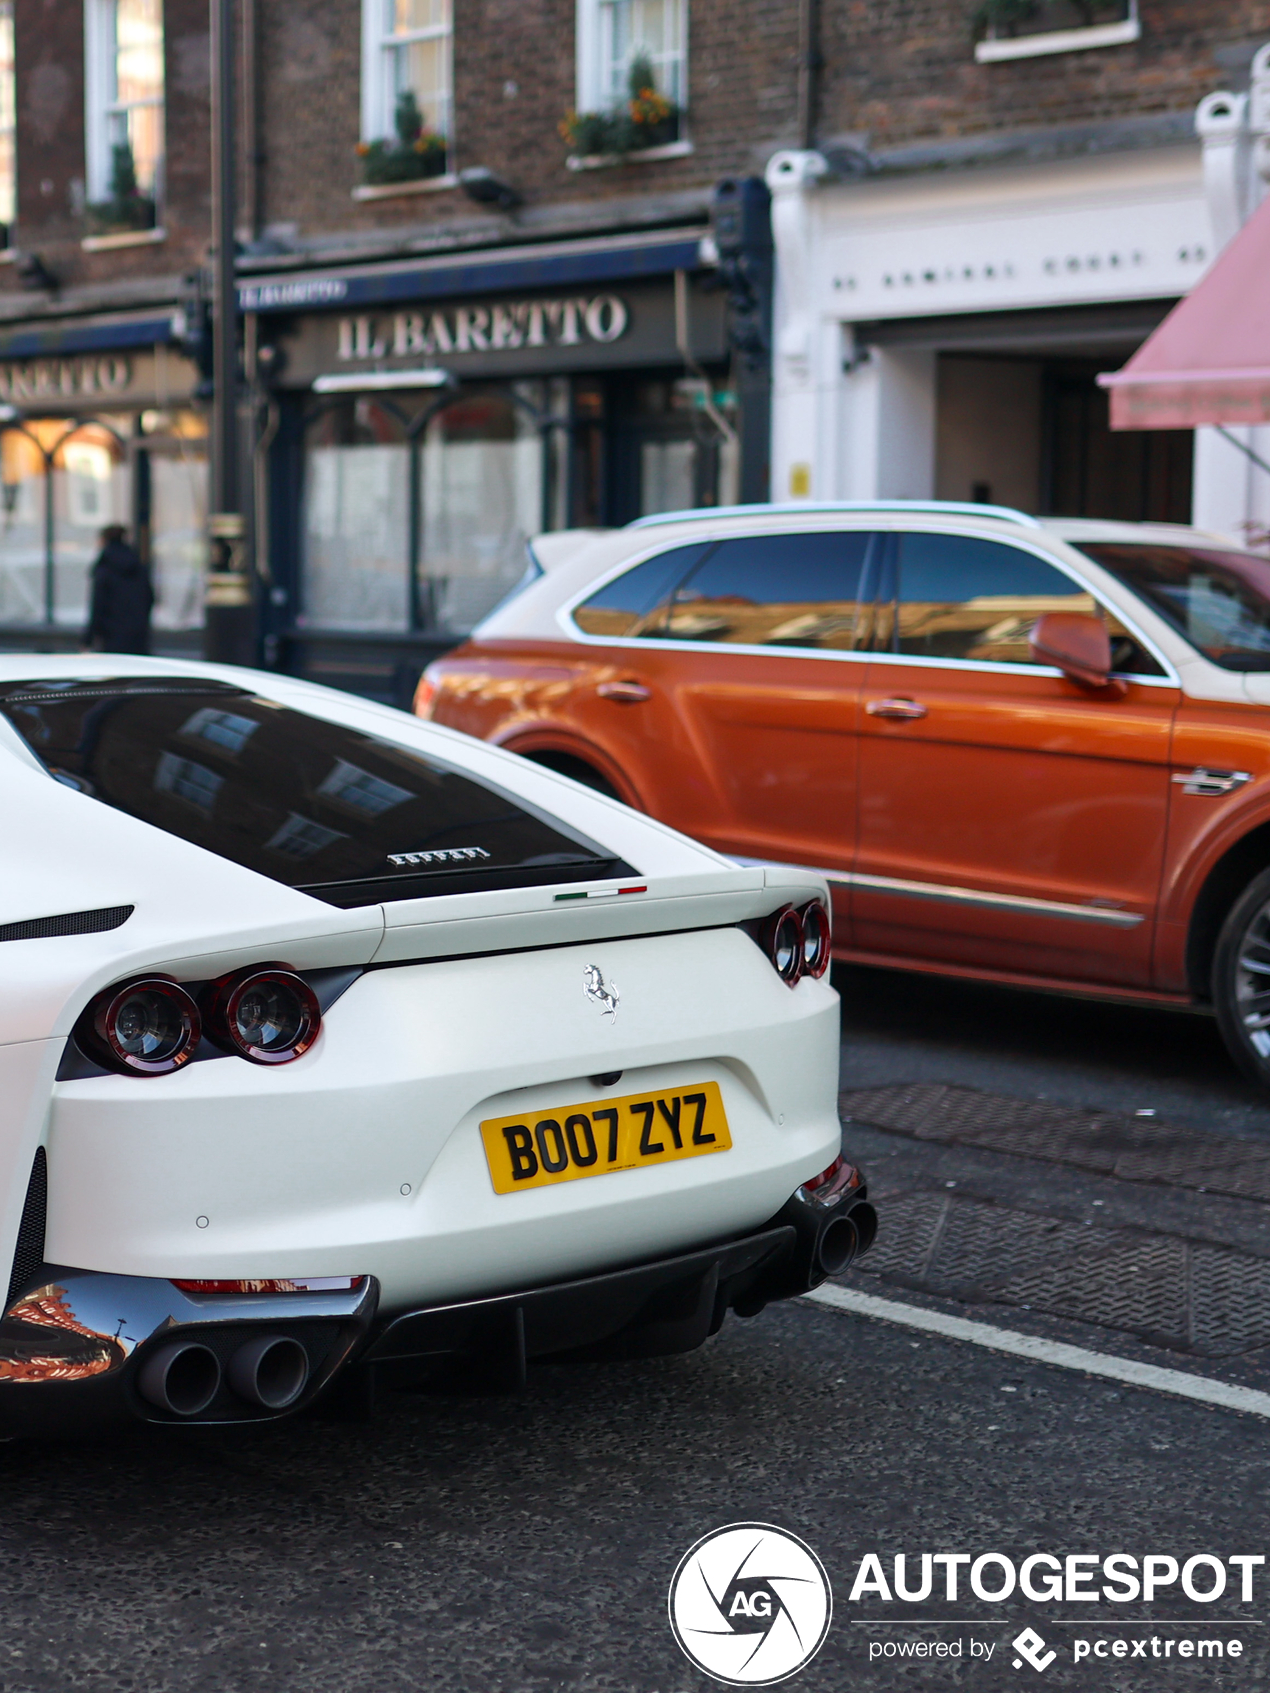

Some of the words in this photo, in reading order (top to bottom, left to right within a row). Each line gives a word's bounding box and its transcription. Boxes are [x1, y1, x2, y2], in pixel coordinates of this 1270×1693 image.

[338, 314, 388, 361] IL
[393, 294, 628, 356] BARETTO
[629, 1092, 716, 1156] ZYZ
